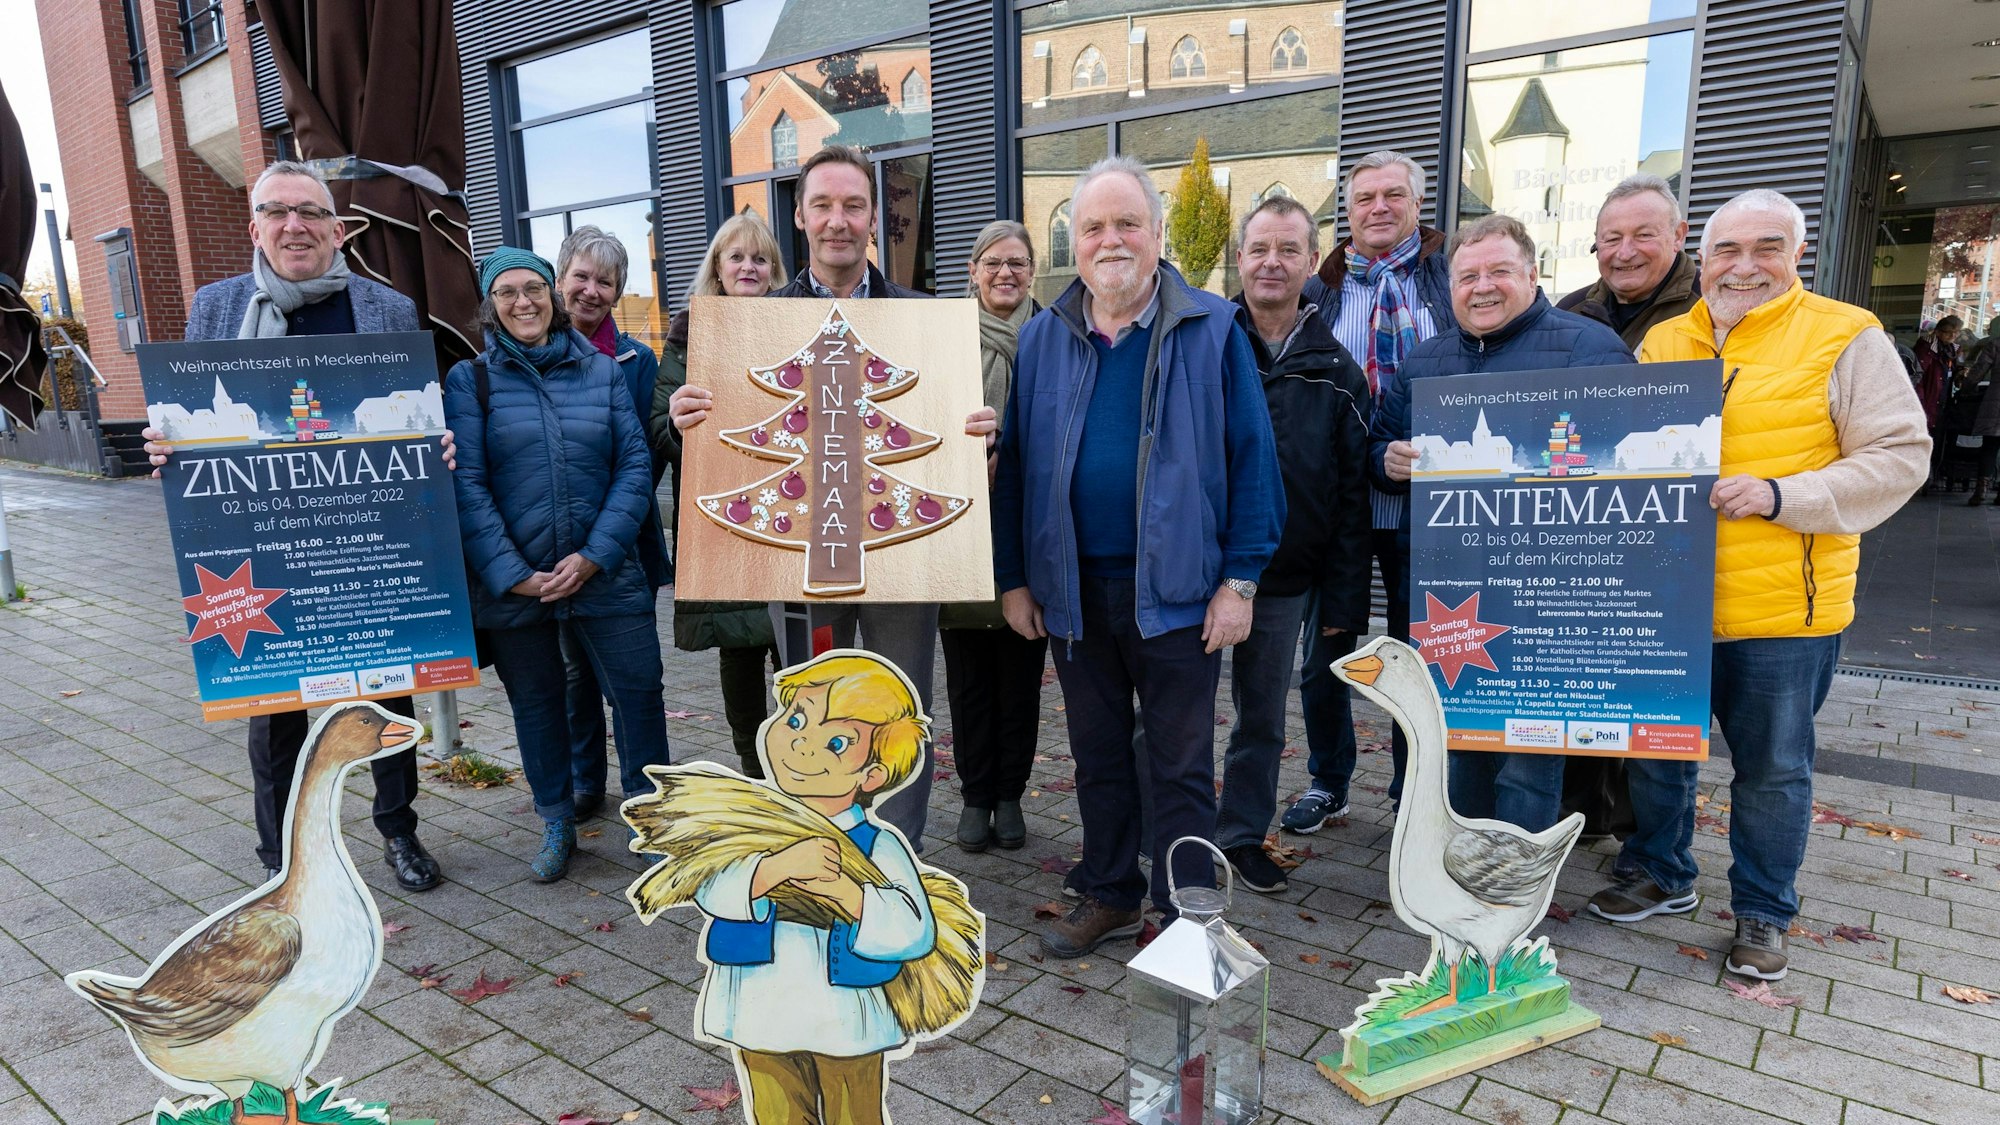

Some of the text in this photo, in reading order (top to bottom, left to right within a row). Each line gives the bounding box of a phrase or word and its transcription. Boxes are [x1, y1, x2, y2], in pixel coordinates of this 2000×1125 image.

[1513, 160, 1626, 190] Bäckerei
[169, 351, 408, 373] Weihnachtszeit in Meckenheim
[1439, 382, 1688, 406] Weihnachtszeit in Meckenheim
[821, 340, 850, 568] ZINTEMAAT
[180, 444, 430, 497] ZINTEMAAT
[222, 487, 404, 514] 02. bis 04. Dezember 2022
[1427, 484, 1696, 526] ZINTEMAAT
[254, 510, 381, 532] auf dem Kirchplatz
[256, 532, 384, 551] Freitag 16.00 21.00 Uhr
[1462, 530, 1655, 546] 02. bis 04. Dezember 2022
[284, 551, 305, 559] 17.00
[306, 549, 338, 557] Feierliche
[340, 546, 371, 554] Eröffnung
[286, 553, 399, 569] 18.30 Weihnachtliches Jazzkonzert
[1489, 551, 1624, 567] auf dem Kirchplatz
[310, 566, 355, 576] Lehrercombo
[382, 560, 423, 569] Musikschule
[289, 576, 420, 596] Samstag 11.30 21.00 Uhr
[1488, 577, 1623, 588] Freitag 16.00 21.00 Uhr
[206, 587, 246, 606] Sonntag
[292, 598, 312, 606] 14.30
[313, 592, 368, 603] Weihnachtslieder
[398, 586, 428, 595] Schulchor
[329, 592, 449, 610] Katholischen Grundschule Meckenheim
[1572, 589, 1607, 598] Eröffnung
[200, 593, 265, 621] Verkaufsoffen
[294, 606, 399, 624] 16.00 Vorstellung Blütenkönigin
[214, 608, 262, 630] 13-18 Uhr
[296, 609, 451, 631] 18.30 Abendkonzert Bonner Saxophonensemble
[1430, 619, 1469, 634] Sonntag
[263, 628, 394, 650] Sonntag 11.30 20.00 Uhr
[1422, 627, 1487, 648] Verkaufsoffen
[1512, 626, 1656, 637] Samstag 11.30 21.00 Uhr
[265, 652, 286, 660] 14.00
[287, 650, 300, 658] Wir
[301, 649, 325, 657] warten
[354, 640, 386, 649] Nikolaus!
[1434, 640, 1483, 659] 13-18 Uhr
[1536, 638, 1594, 646] Weihnachtslieder
[1596, 648, 1640, 656] Grundschule
[211, 650, 453, 684] 17.00 Weihnachtsprogramm Blasorchester Stadtsoldaten Meckenheim
[229, 665, 250, 673] 16.00
[252, 656, 305, 670] Weihnachtliches
[314, 652, 343, 663] Cappella
[345, 650, 371, 659] Konzert
[1535, 656, 1574, 666] Vorstellung
[1576, 657, 1626, 667] Blütenkönigin
[384, 673, 405, 683] Pohl
[1613, 667, 1686, 675] Saxophonensemble
[1477, 677, 1616, 690] Sonntag 11.30 20.00 Uhr
[1461, 698, 1515, 706] Weihnachtliches
[1524, 700, 1555, 708] Cappella
[1570, 692, 1605, 700] Nikolaus!
[1514, 708, 1563, 716] Blasorchester
[1579, 710, 1630, 719] Stadtsoldaten
[1632, 712, 1680, 720] Meckenheim
[1596, 731, 1619, 740] Pohl
